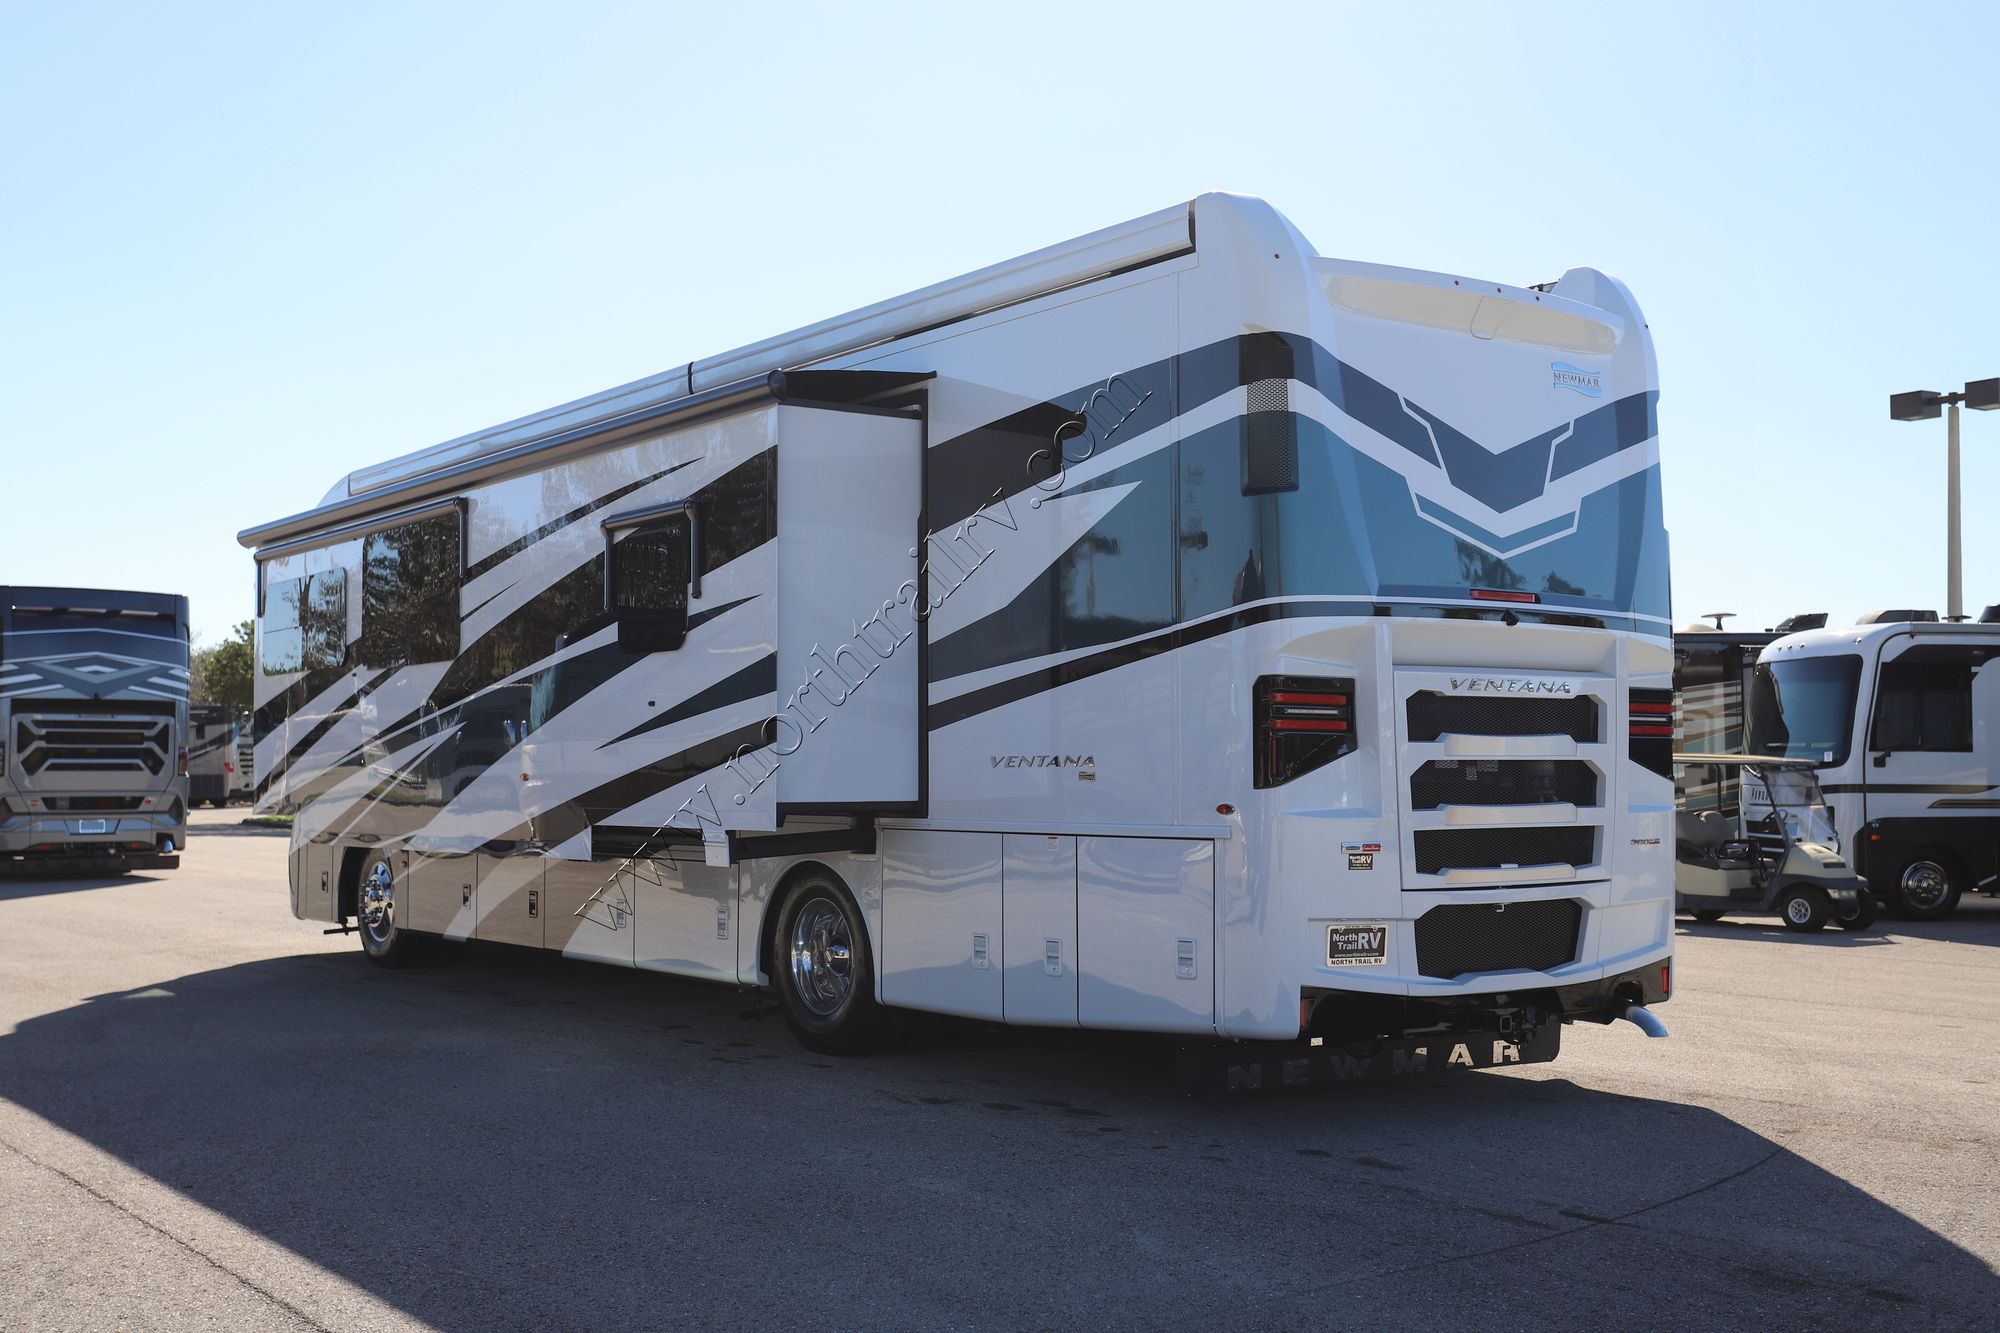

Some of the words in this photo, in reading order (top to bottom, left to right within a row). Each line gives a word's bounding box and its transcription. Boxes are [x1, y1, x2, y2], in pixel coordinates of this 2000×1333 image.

[1553, 371, 1601, 389] NEWMAR
[1450, 677, 1571, 694] VENTANA
[990, 755, 1096, 768] VENTANA
[1361, 855, 1372, 864] RV
[1332, 933, 1358, 942] North
[1358, 932, 1382, 950] RV
[1337, 942, 1358, 950] Trail
